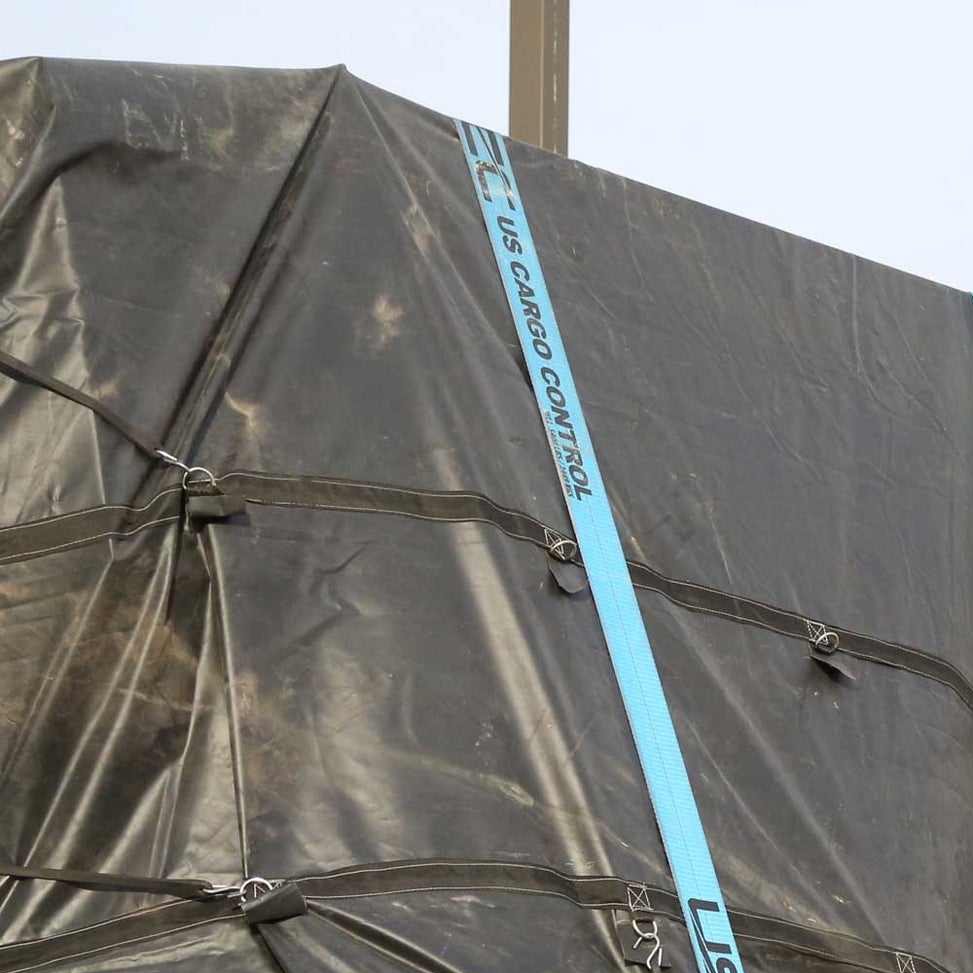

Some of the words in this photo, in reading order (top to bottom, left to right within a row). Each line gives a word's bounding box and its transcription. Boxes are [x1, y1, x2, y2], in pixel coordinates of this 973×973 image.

[496, 215, 523, 255] US
[510, 261, 552, 361] CARGO
[540, 366, 593, 502] CONTROL
